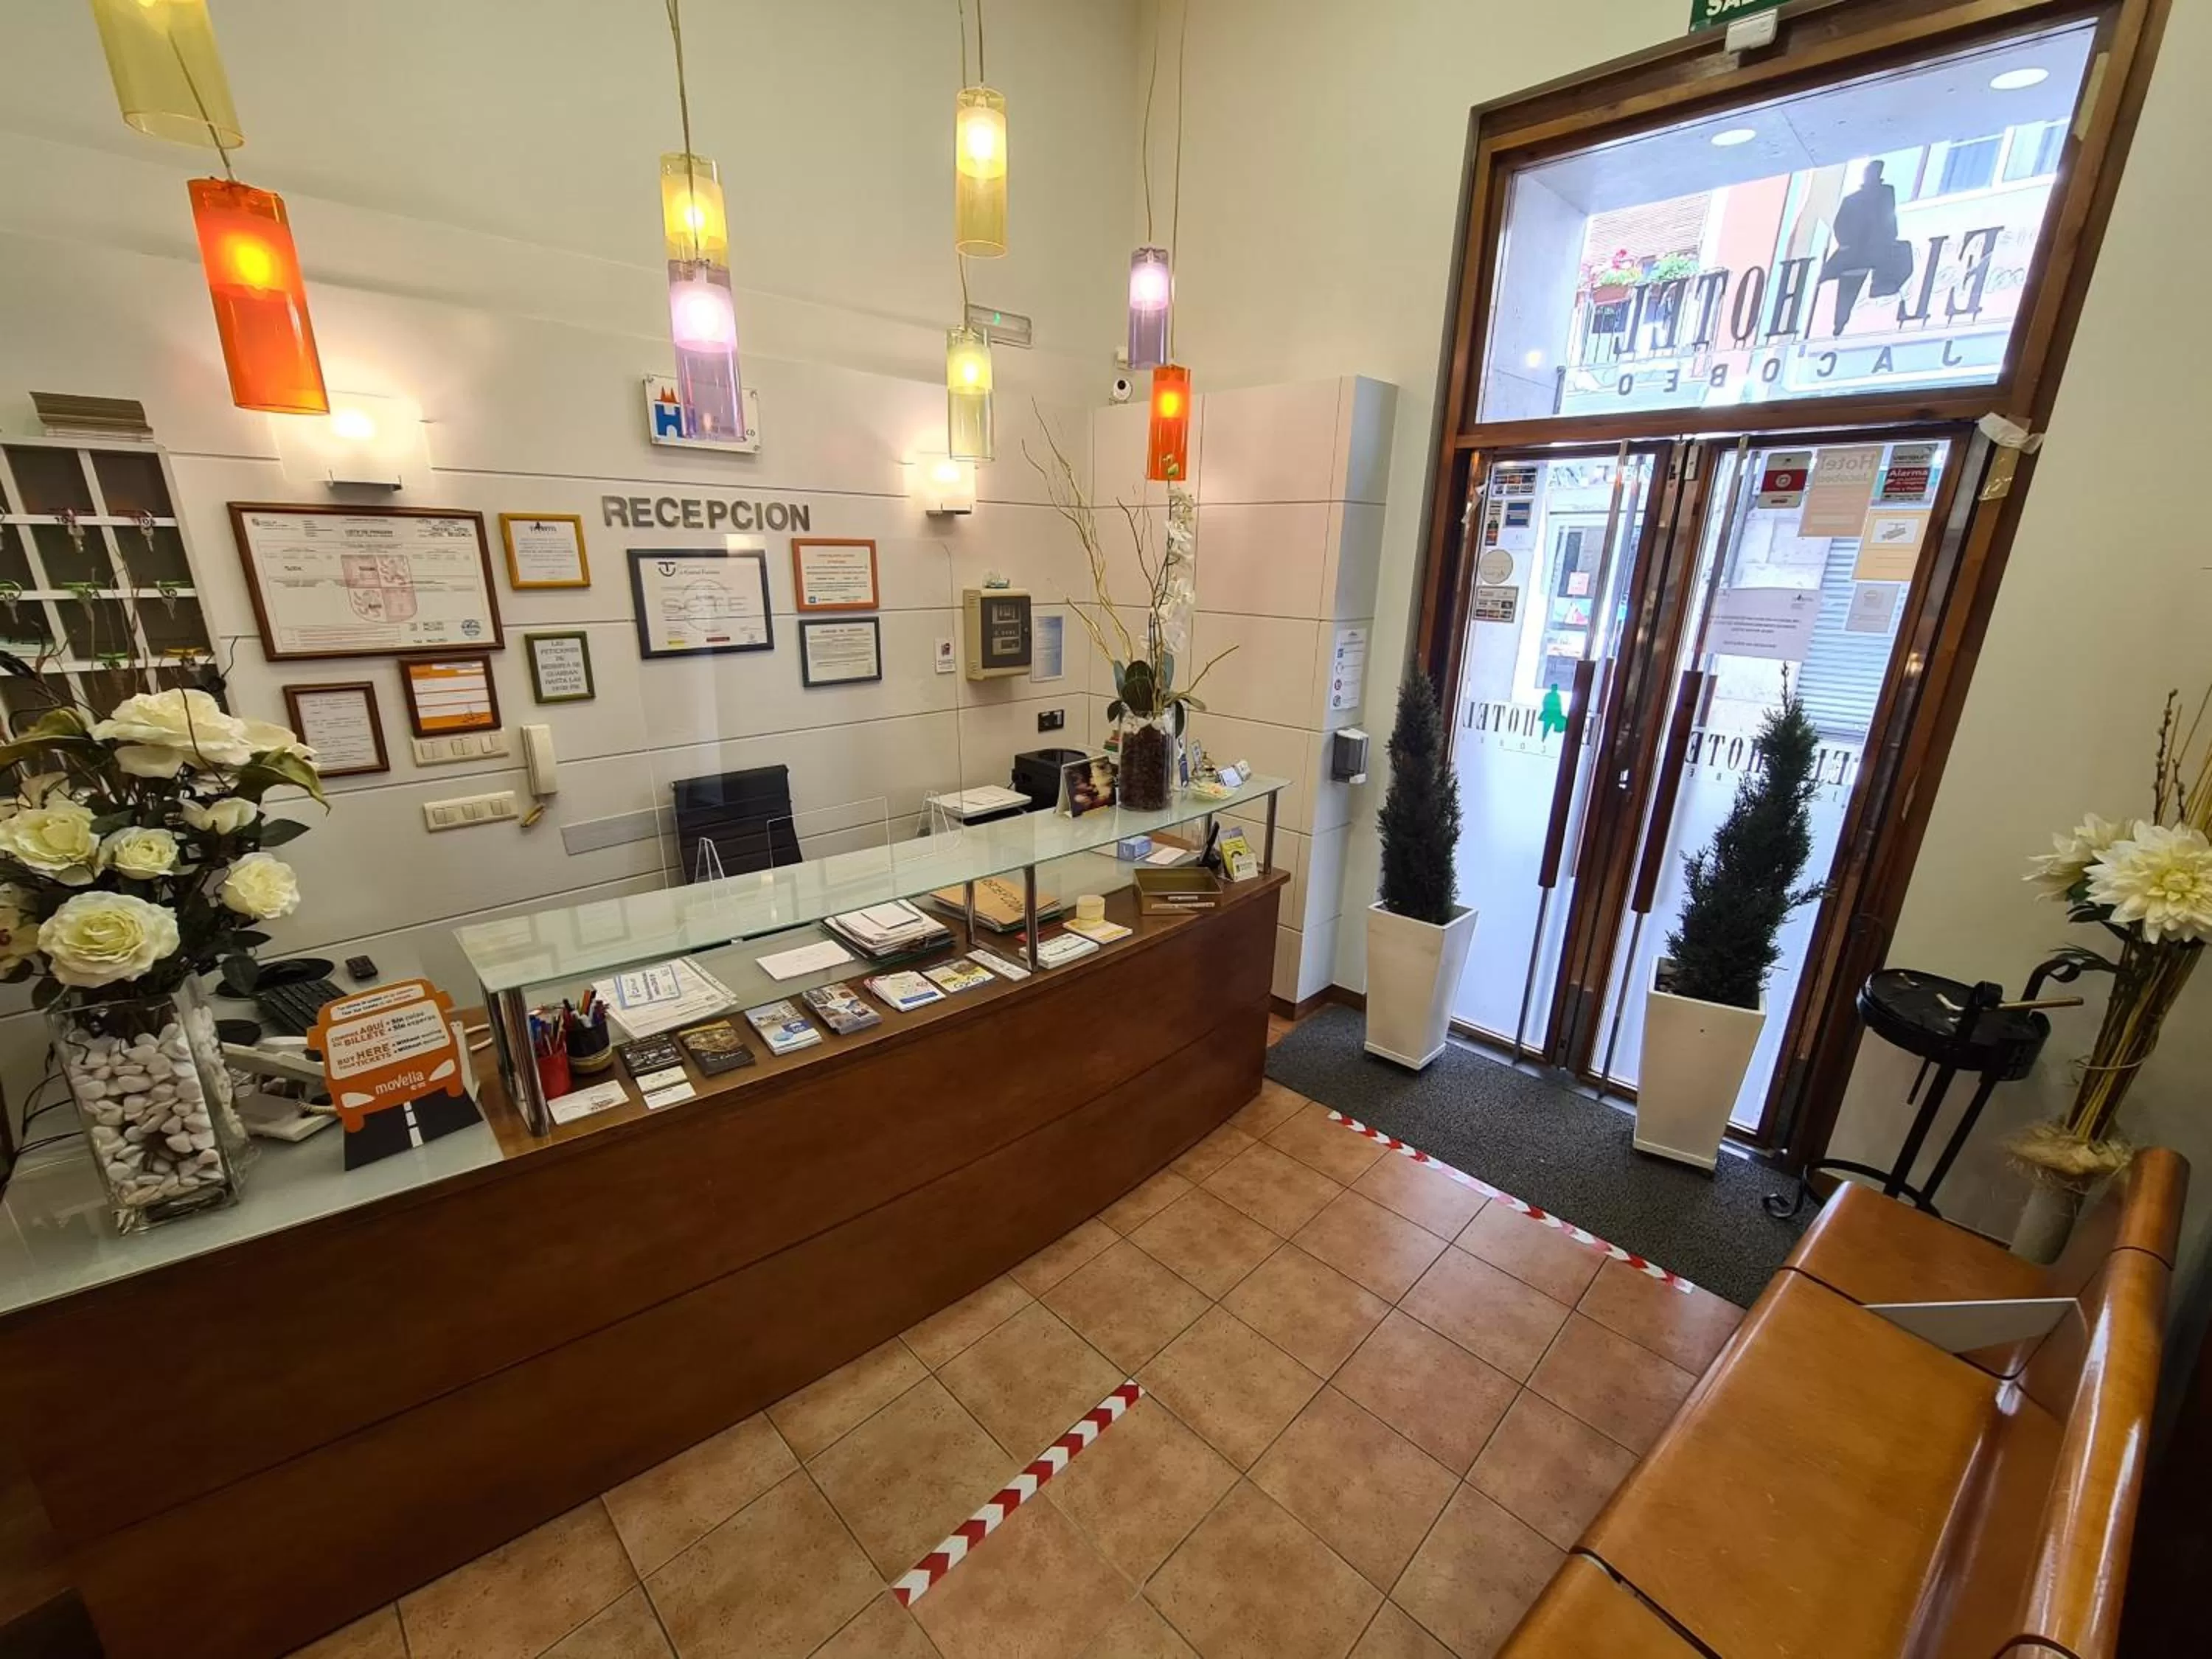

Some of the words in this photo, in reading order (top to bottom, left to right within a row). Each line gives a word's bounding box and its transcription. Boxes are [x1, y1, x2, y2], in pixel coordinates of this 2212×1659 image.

[1889, 469, 1928, 482] Alarma
[601, 495, 810, 532] RECEPCION
[355, 1043, 390, 1059] HERE
